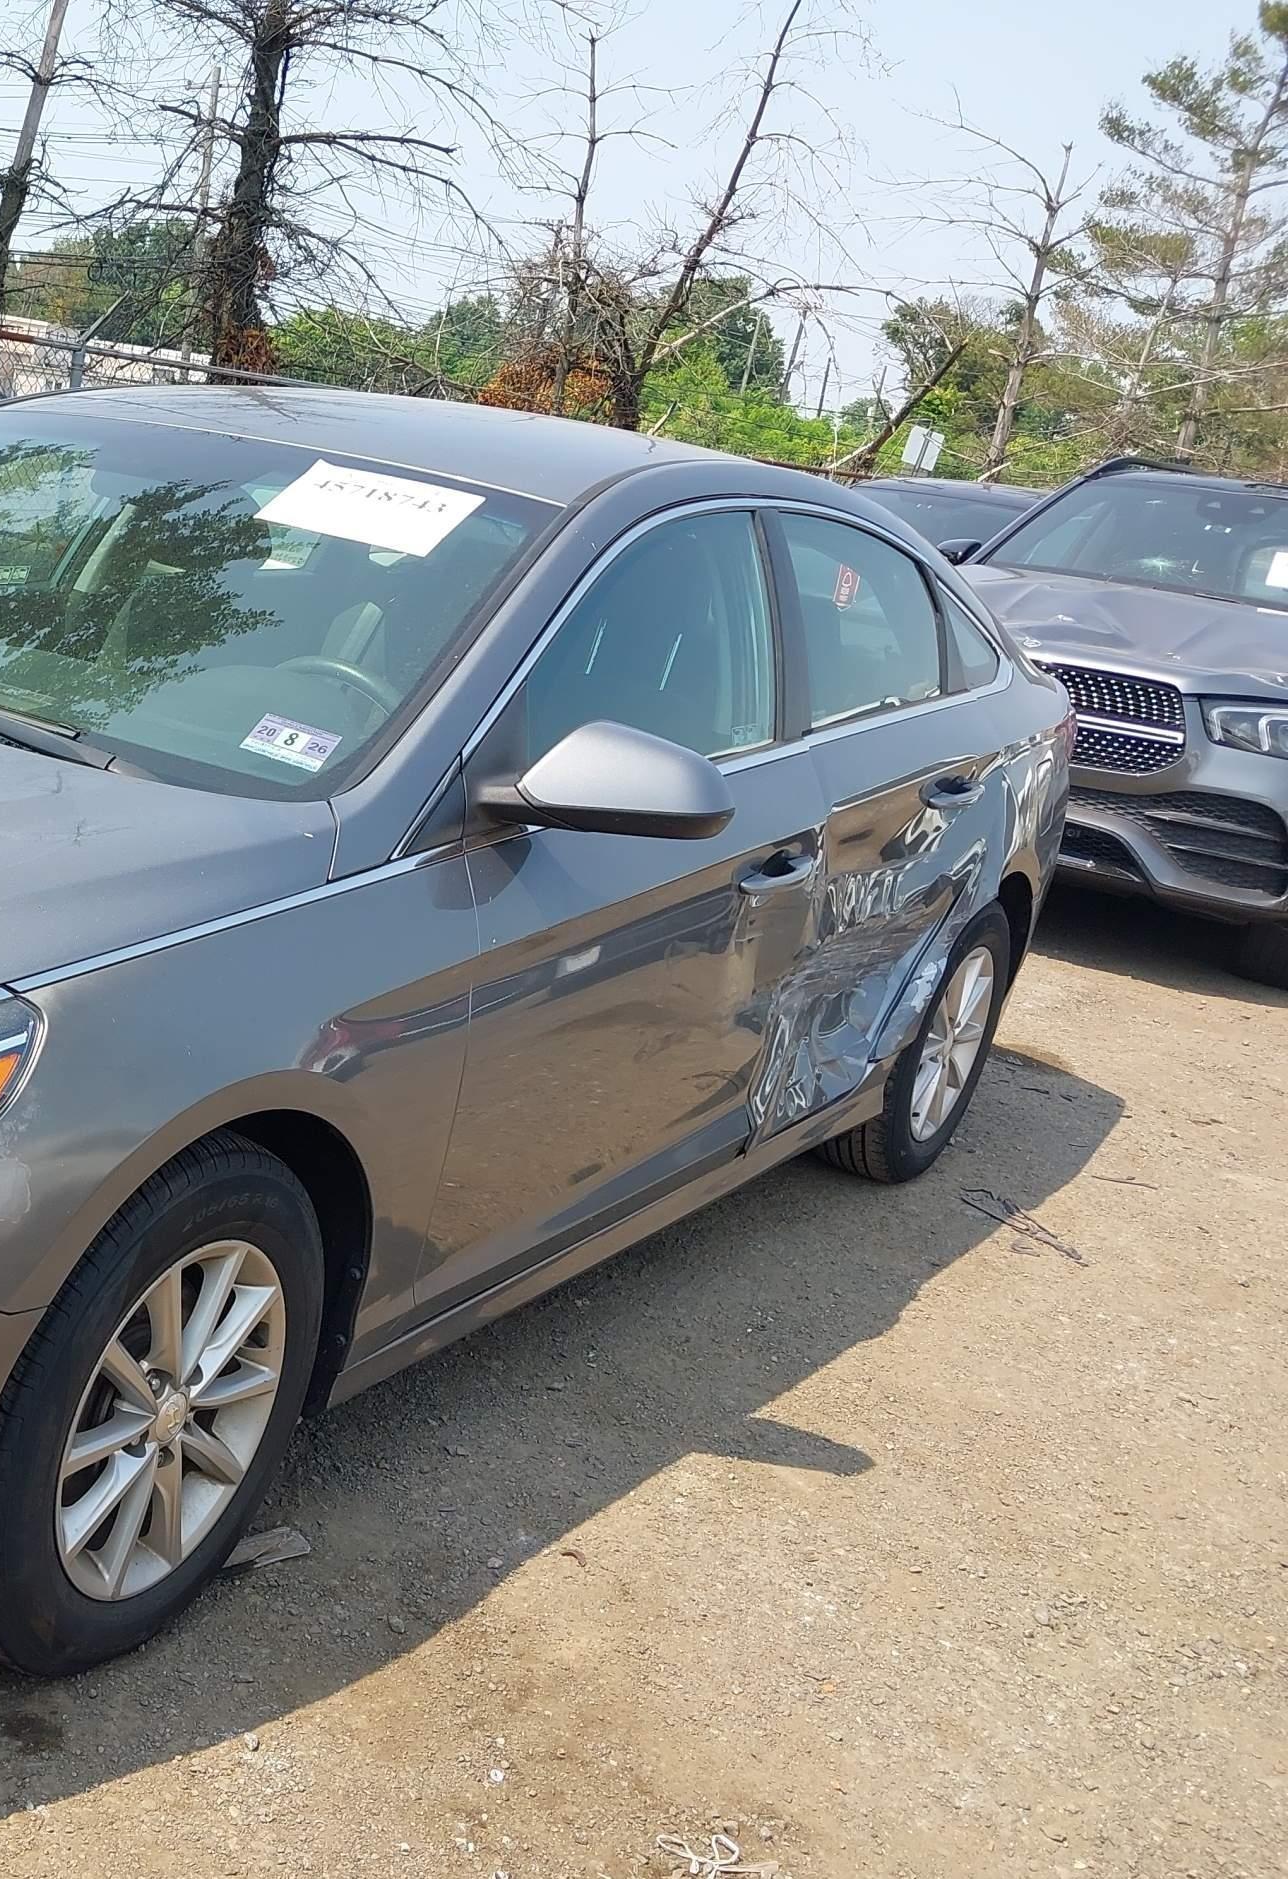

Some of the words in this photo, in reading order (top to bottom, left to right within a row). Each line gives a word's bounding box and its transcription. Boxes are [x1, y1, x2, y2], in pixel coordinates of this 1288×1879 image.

[312, 478, 448, 514] 45718743
[256, 725, 277, 737] 20
[283, 732, 300, 746] 8
[307, 742, 329, 755] 26
